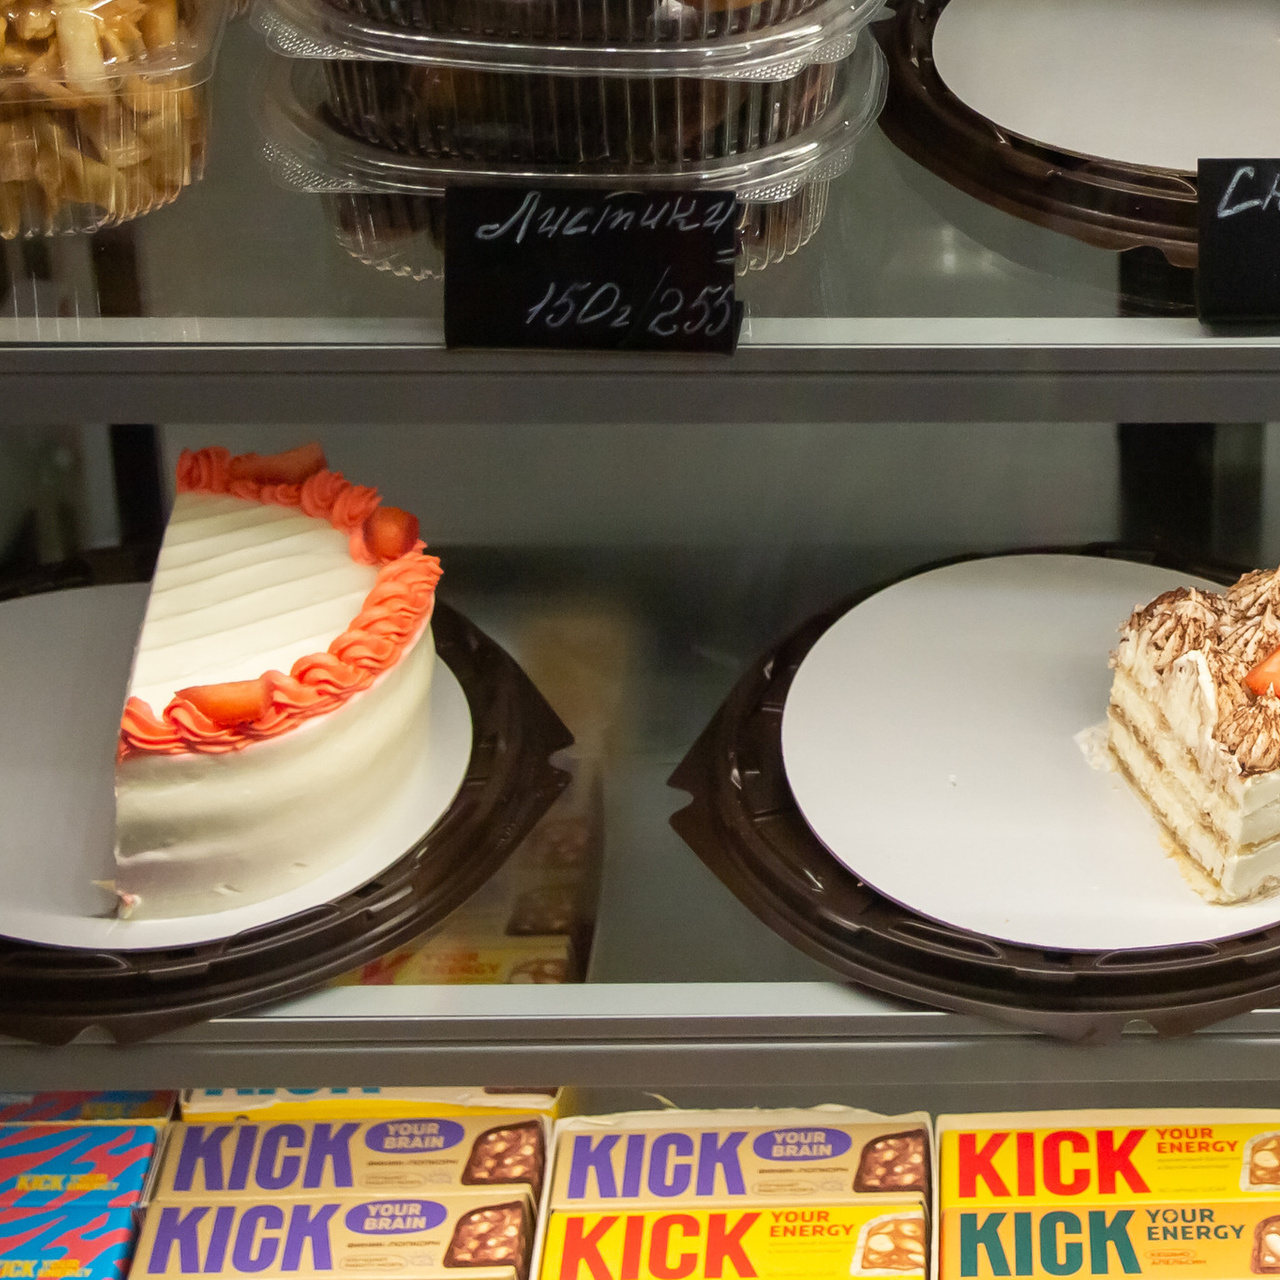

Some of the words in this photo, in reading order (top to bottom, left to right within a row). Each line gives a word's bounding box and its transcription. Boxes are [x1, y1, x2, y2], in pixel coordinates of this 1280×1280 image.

[387, 1123, 440, 1135] YOUR
[1156, 1128, 1214, 1140] YOUR
[383, 1136, 445, 1149] BRAIN
[774, 1131, 826, 1144] YOUR
[771, 1144, 832, 1157] BRAIN
[1157, 1141, 1238, 1154] ENERGY
[173, 1122, 361, 1192] KICK
[958, 1129, 1152, 1198] KICK
[567, 1131, 749, 1199] KICK
[367, 1203, 422, 1216] YOUR
[1146, 1208, 1215, 1223] YOUR
[363, 1216, 427, 1230] BRAIN
[771, 1211, 829, 1223] YOUR
[770, 1224, 855, 1237] ENERGY
[1147, 1224, 1246, 1240] ENERGY
[147, 1203, 342, 1274] KICK
[960, 1209, 1143, 1278] KICK
[559, 1212, 763, 1280] KICK
